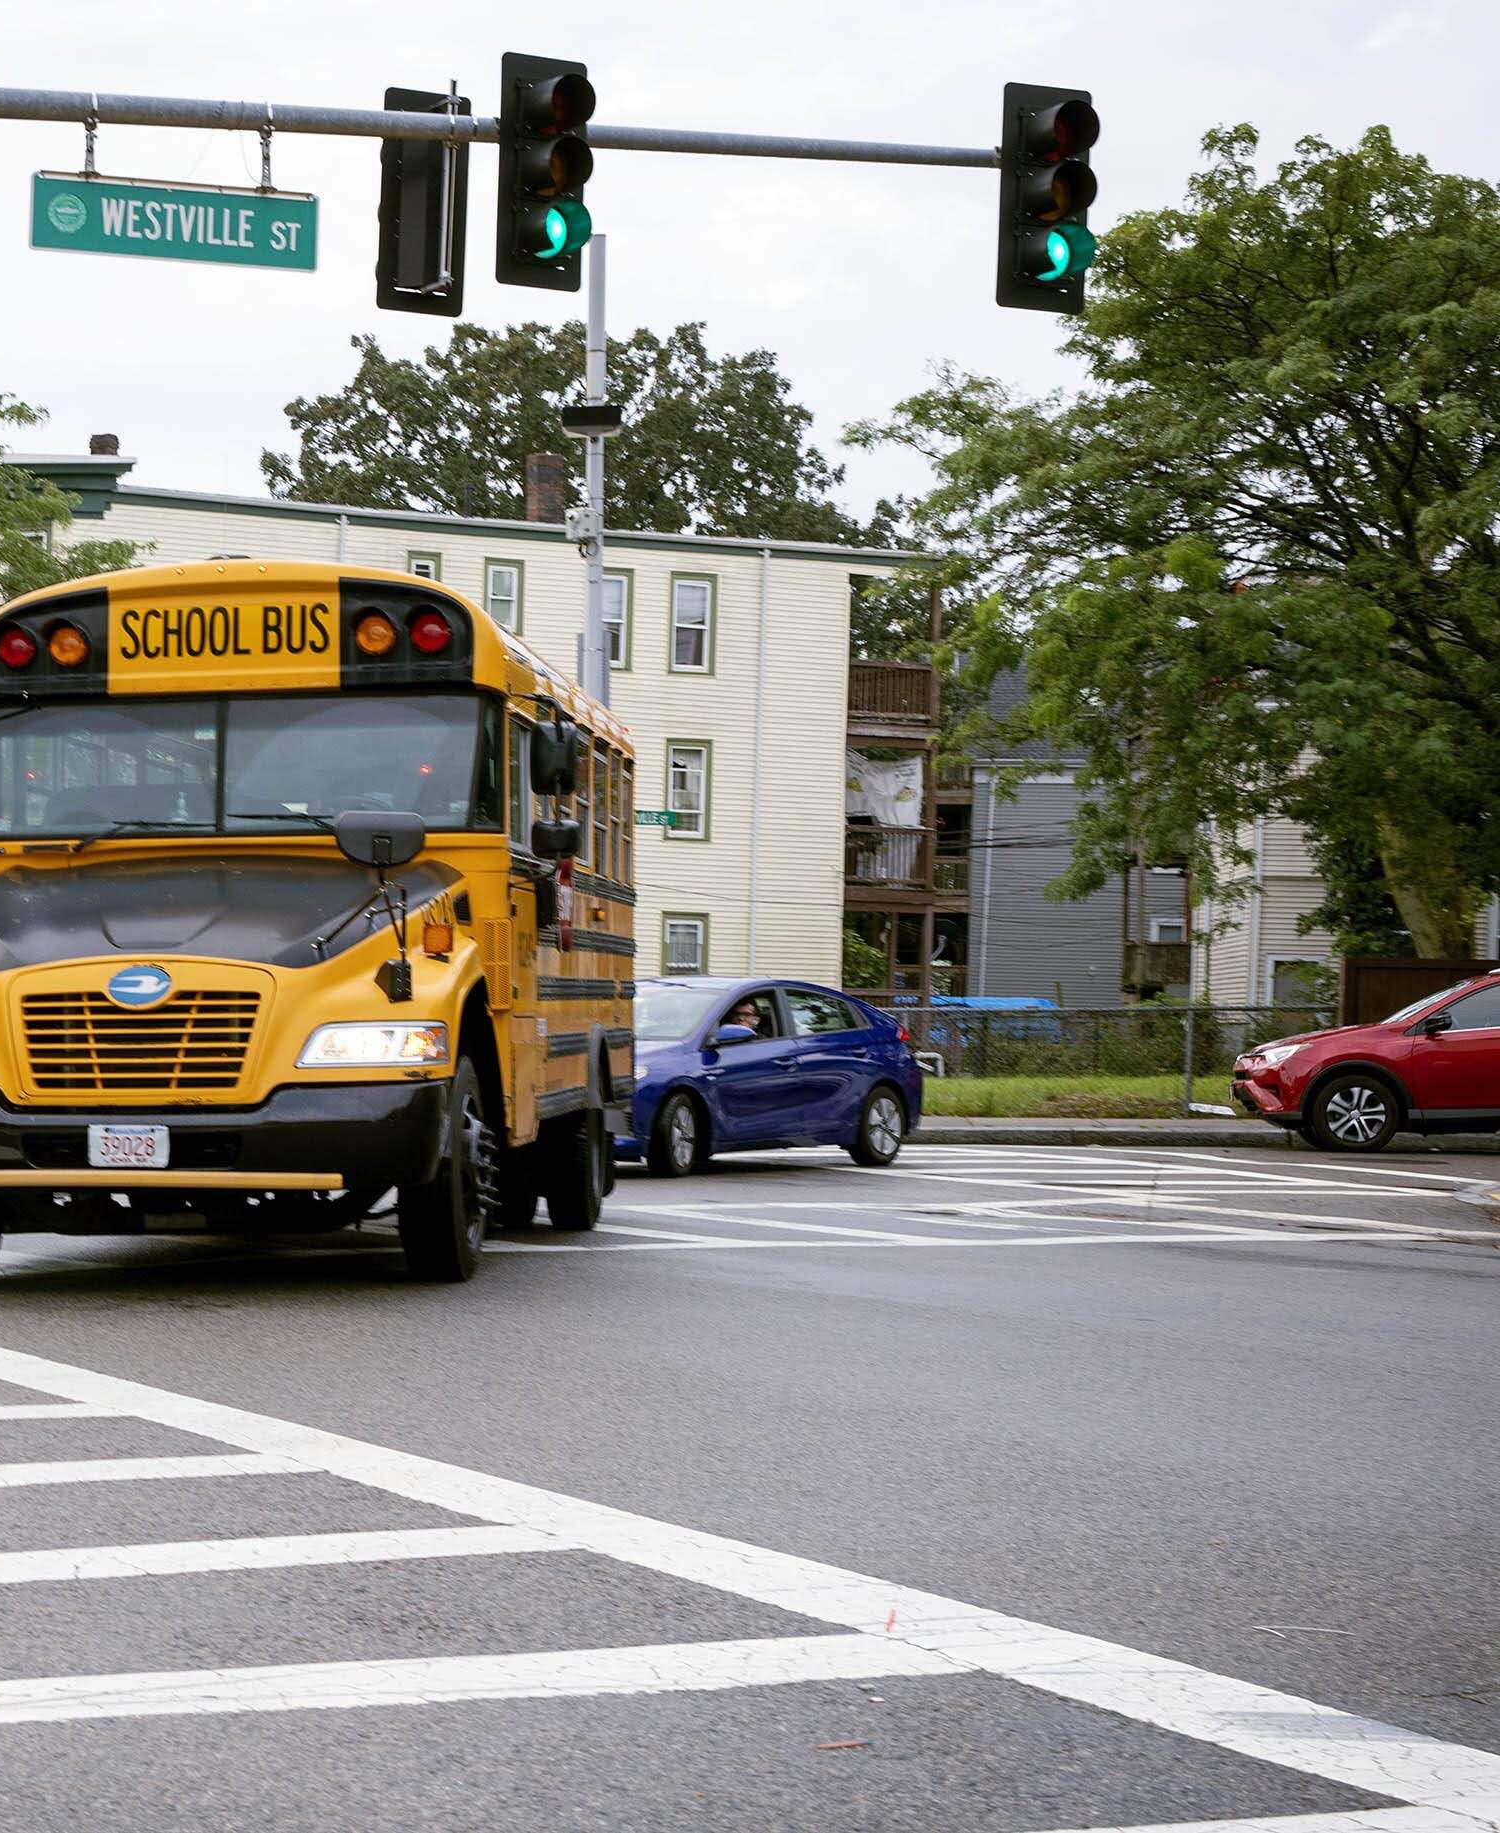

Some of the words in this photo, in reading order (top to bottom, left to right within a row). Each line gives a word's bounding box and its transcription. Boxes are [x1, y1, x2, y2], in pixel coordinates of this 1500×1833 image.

[101, 197, 255, 249] WESTVILLE
[269, 220, 302, 252] ST
[120, 607, 252, 660] SCHOOL
[262, 603, 330, 654] BUS
[100, 1135, 156, 1157] 39028
